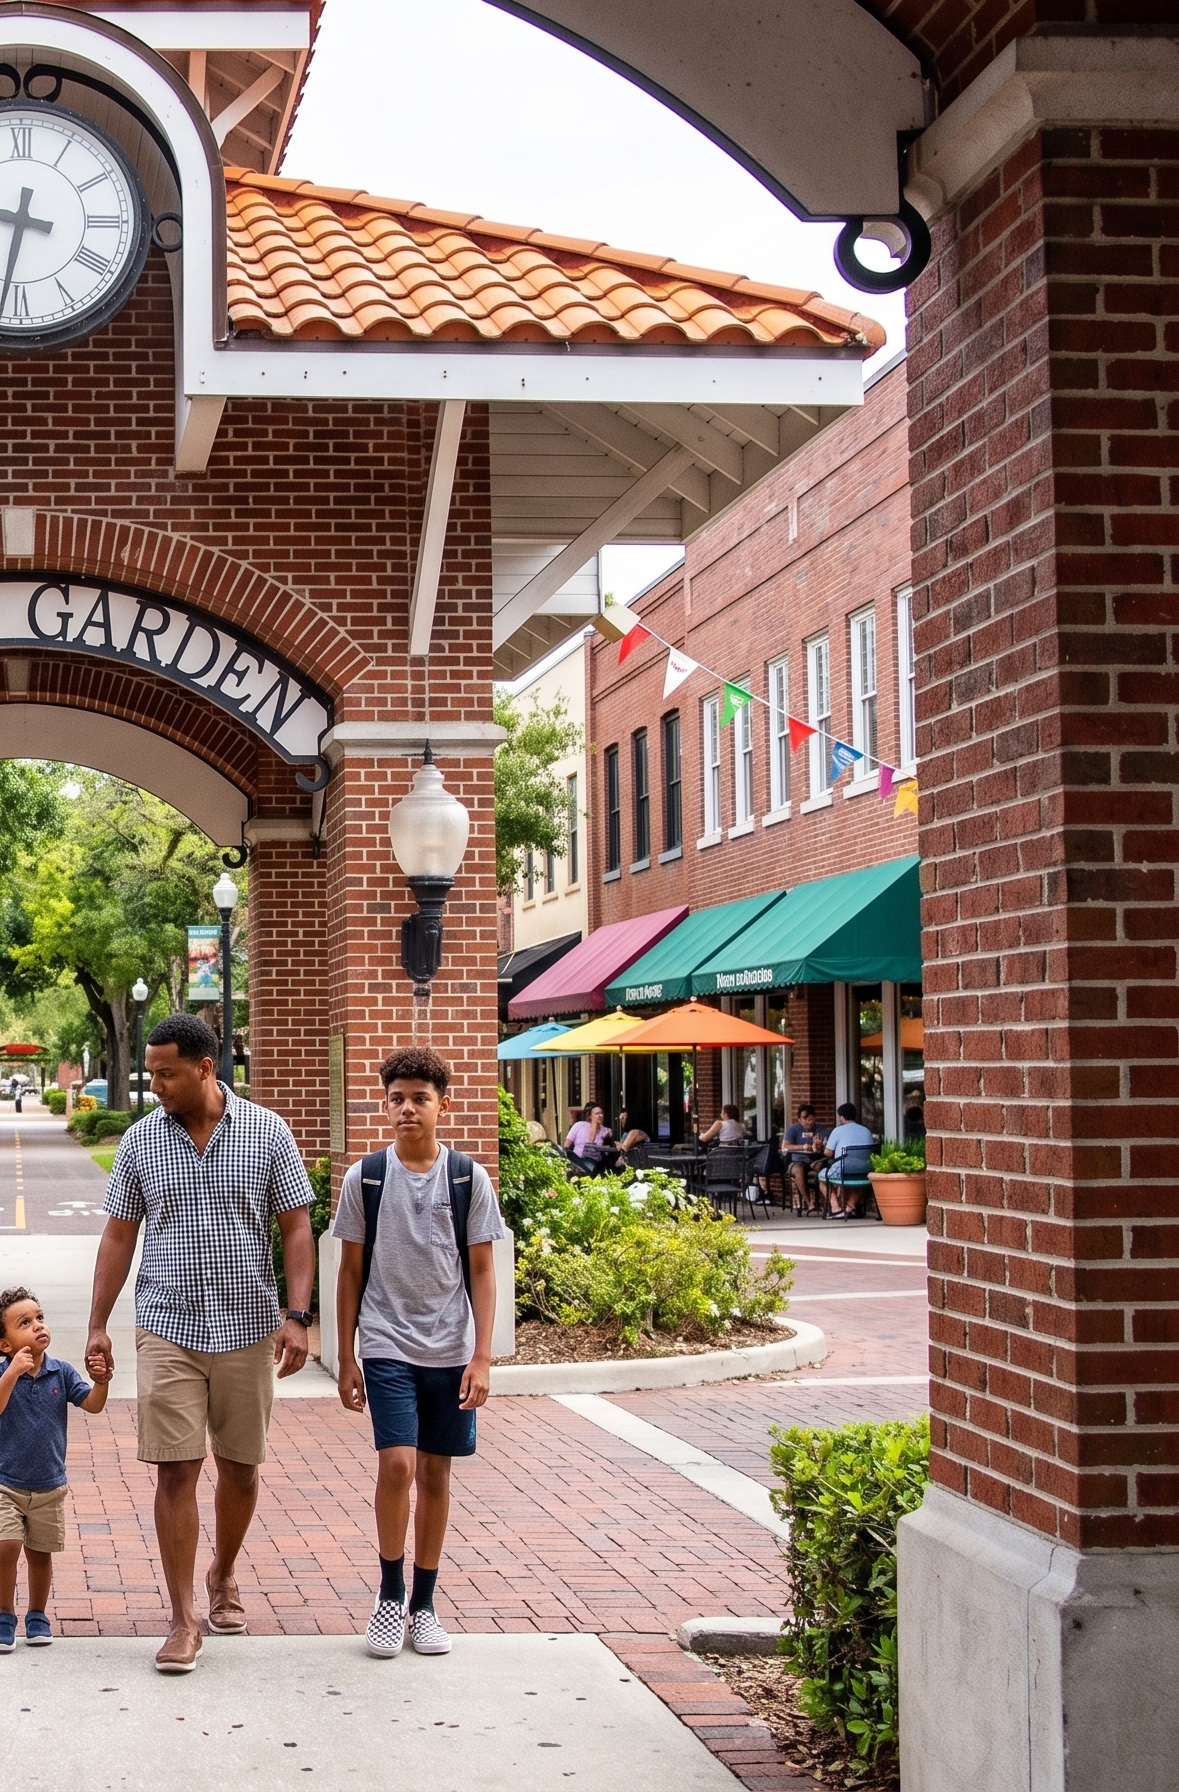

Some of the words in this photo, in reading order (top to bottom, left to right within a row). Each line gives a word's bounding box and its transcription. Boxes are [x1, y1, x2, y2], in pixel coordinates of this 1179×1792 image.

[10, 127, 33, 158] XII
[53, 139, 72, 167] I
[77, 170, 108, 193] II
[87, 214, 120, 229] III
[13, 285, 30, 317] VI
[55, 277, 75, 306] V
[27, 583, 314, 739] GARDEN
